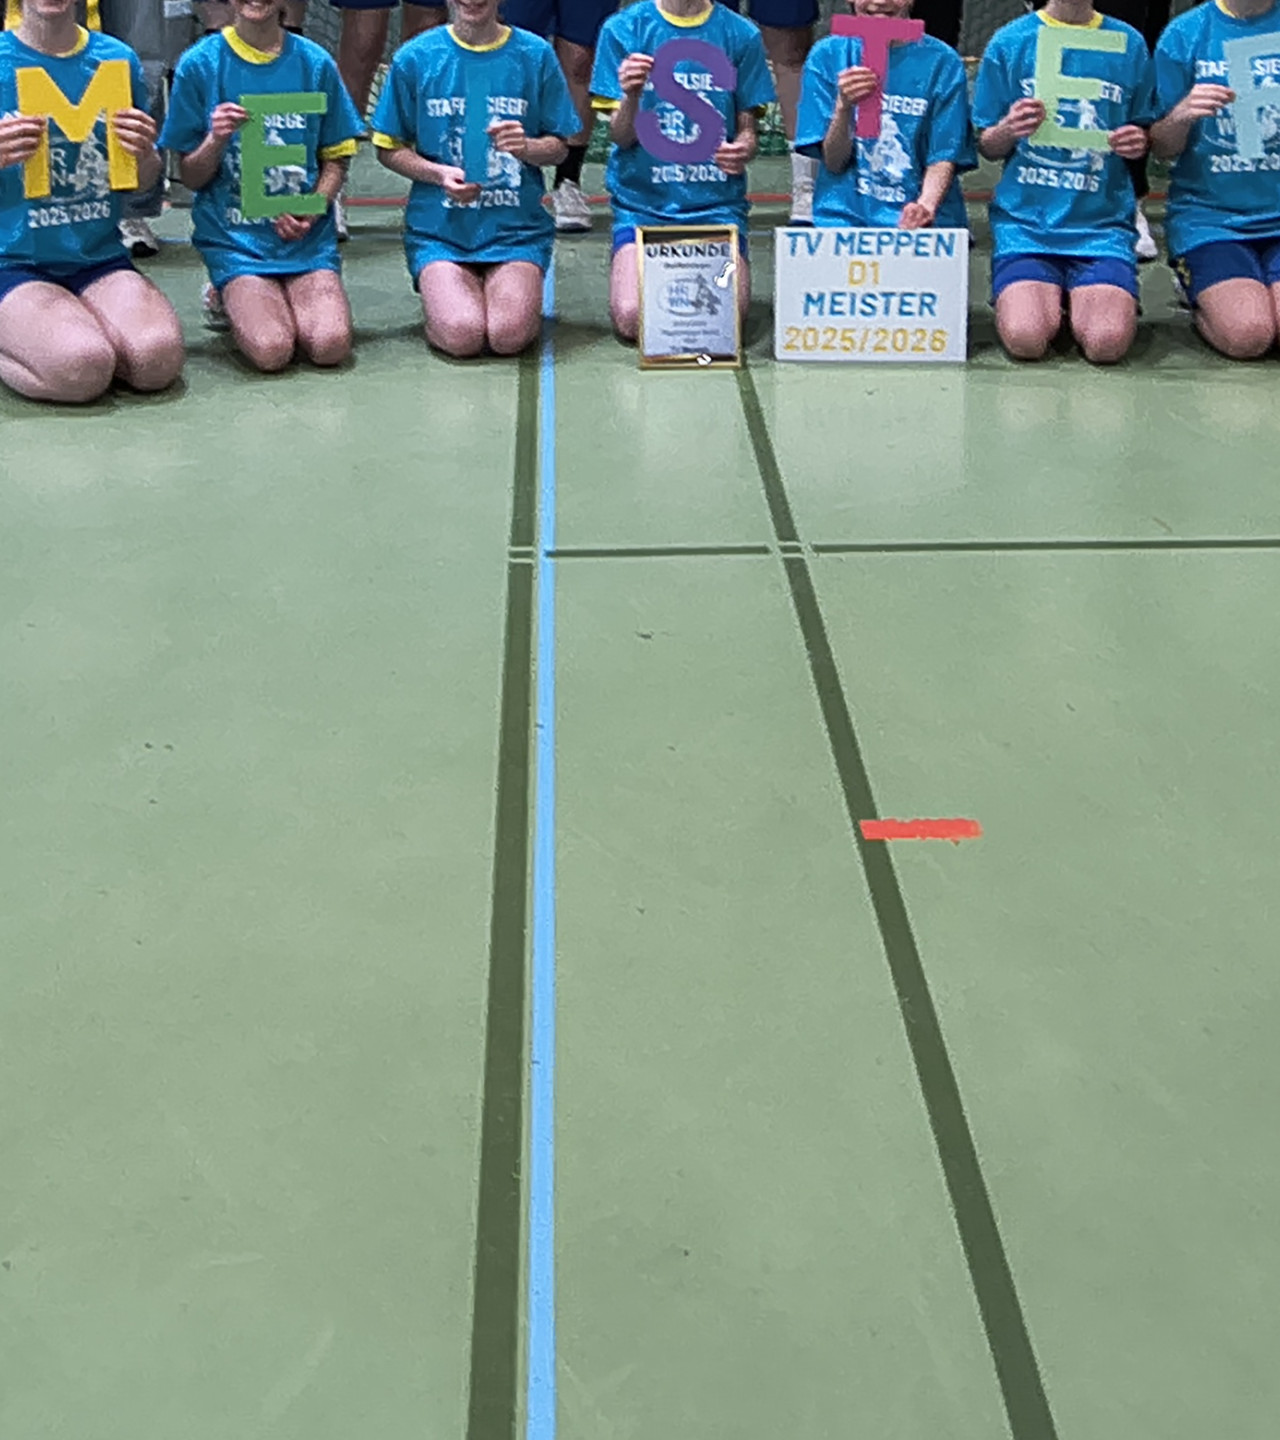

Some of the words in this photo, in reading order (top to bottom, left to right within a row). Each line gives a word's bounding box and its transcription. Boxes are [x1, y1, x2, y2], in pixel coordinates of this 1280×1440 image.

[27, 200, 111, 229] 2025/2026
[645, 244, 731, 259] URKUNDE
[784, 231, 823, 257] TV
[833, 231, 957, 257] MEPPEN
[803, 292, 938, 317] MEISTER
[783, 327, 950, 353] 2025/2026
